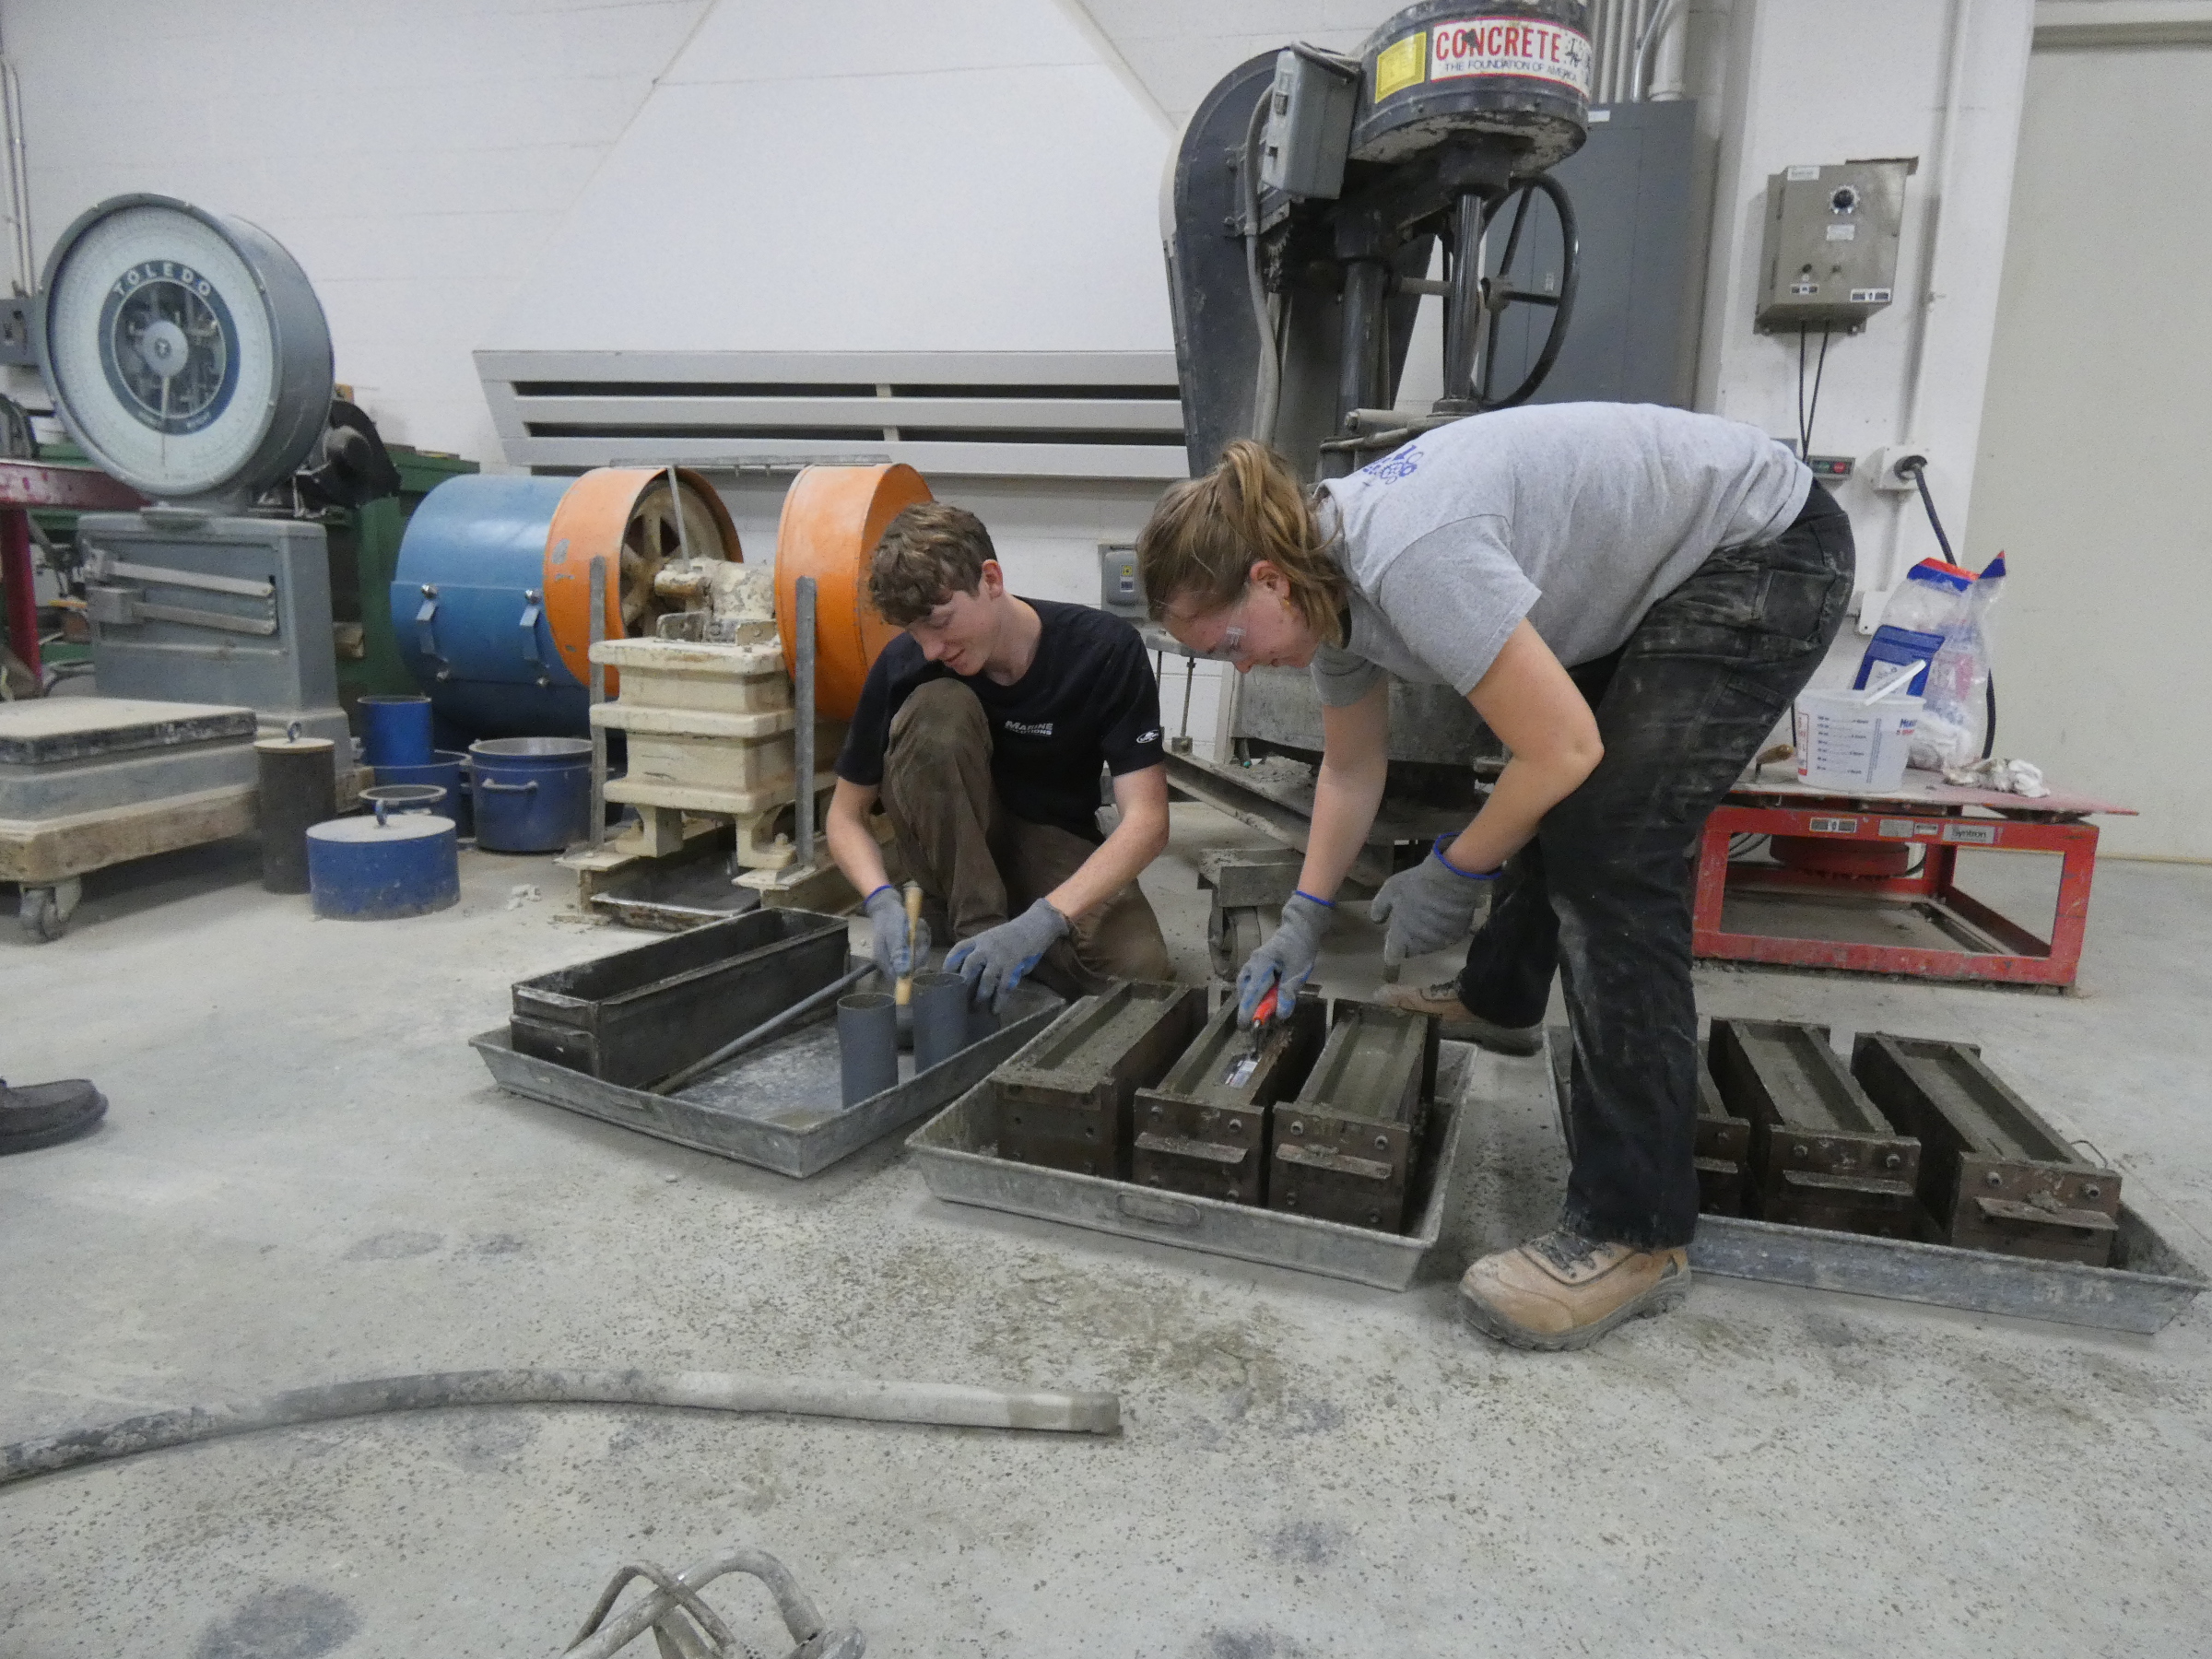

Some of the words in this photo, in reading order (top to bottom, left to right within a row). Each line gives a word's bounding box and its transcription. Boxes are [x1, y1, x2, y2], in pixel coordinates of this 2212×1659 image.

[1436, 26, 1561, 63] CONCRETE
[1445, 62, 1464, 72] THE
[1468, 59, 1531, 71] FOUNDATION
[1532, 62, 1545, 72] OF
[113, 263, 210, 295] TOLEDO
